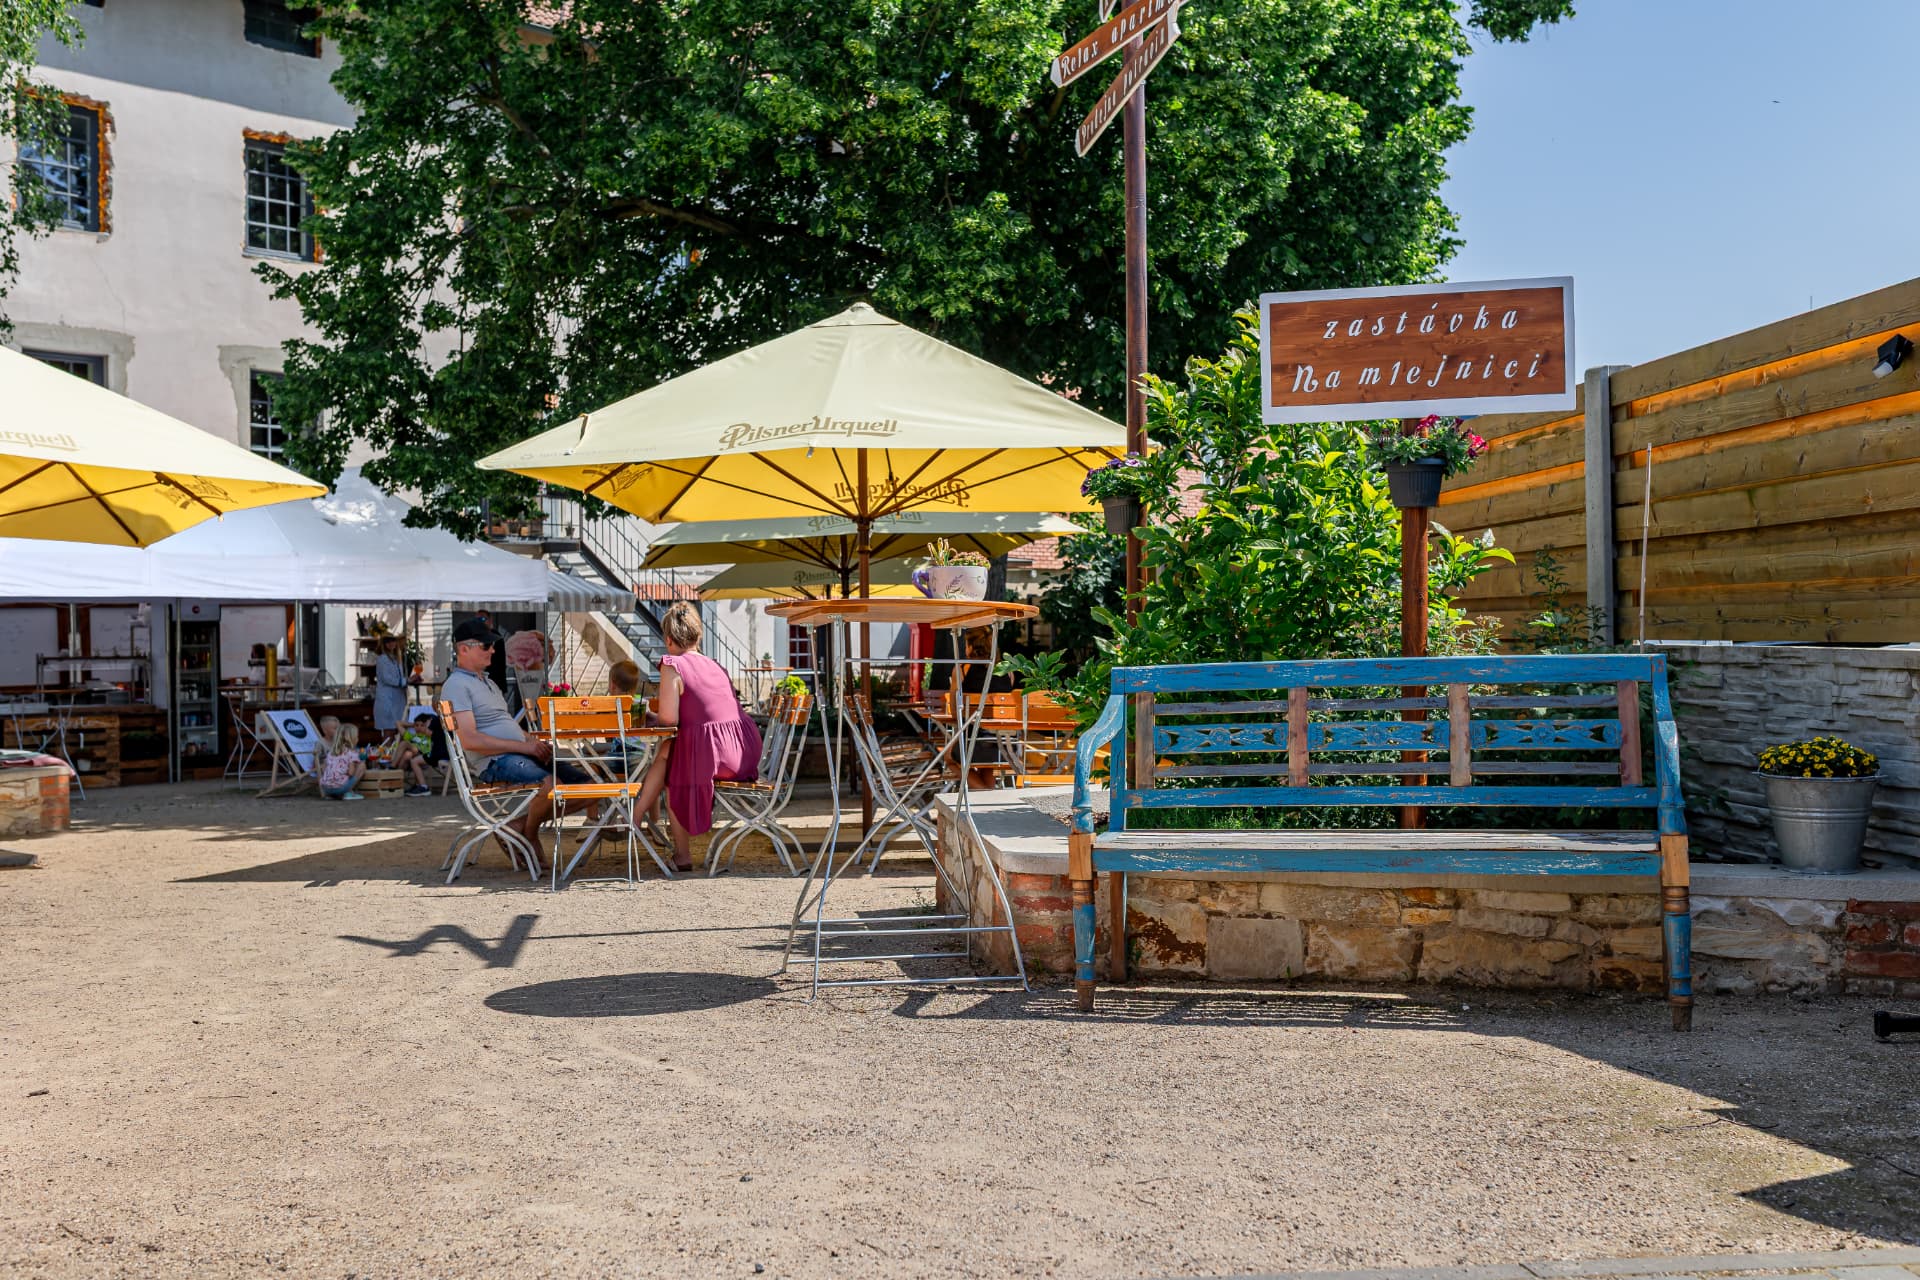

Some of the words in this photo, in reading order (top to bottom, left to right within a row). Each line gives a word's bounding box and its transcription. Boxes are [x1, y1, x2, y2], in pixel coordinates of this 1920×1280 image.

[1061, 41, 1098, 79] Relax
[1322, 302, 1518, 340] zastávka
[1292, 363, 1342, 393] Na
[1358, 353, 1541, 388] mlejnici
[718, 421, 812, 450] Pilsner
[810, 415, 899, 438] Urquell
